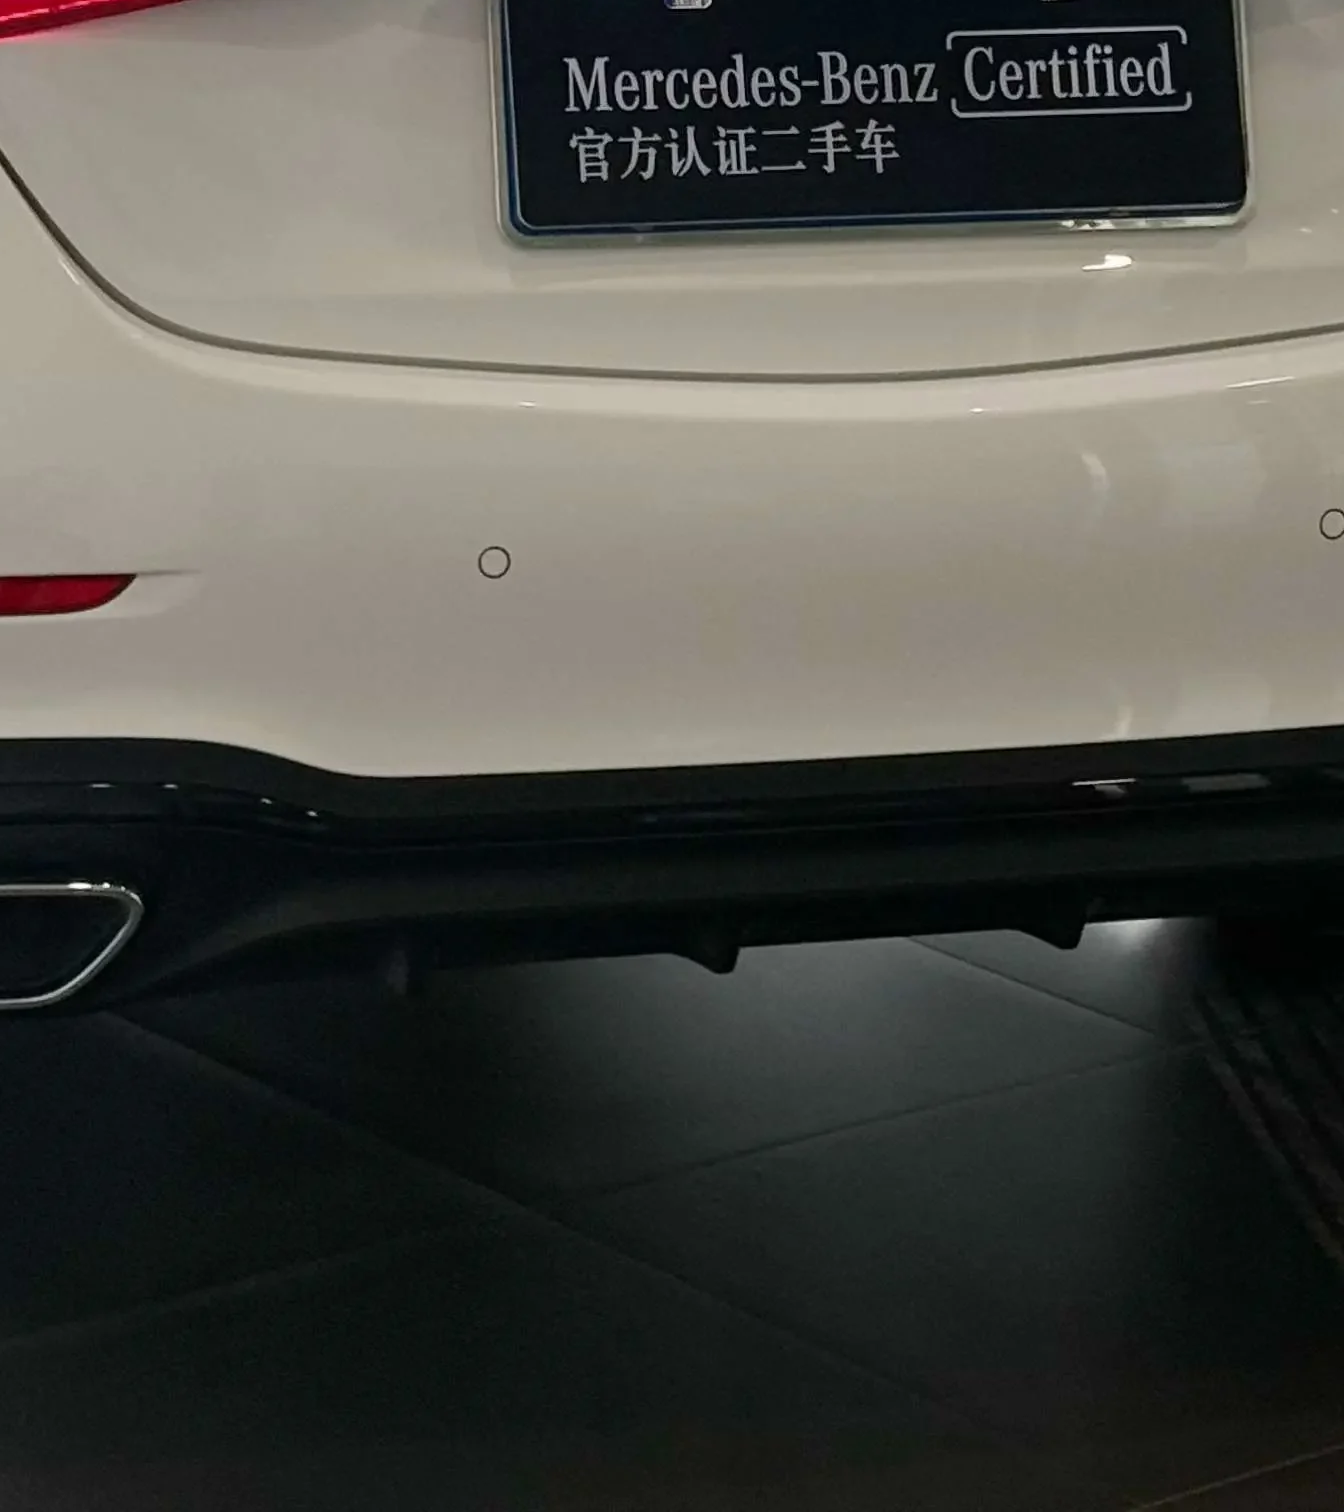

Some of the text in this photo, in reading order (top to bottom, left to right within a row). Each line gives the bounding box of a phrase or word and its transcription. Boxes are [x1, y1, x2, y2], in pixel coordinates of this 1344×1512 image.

[562, 42, 1178, 113] Mercedes-Benz Certified
[568, 118, 901, 184] 官方认证二手车
